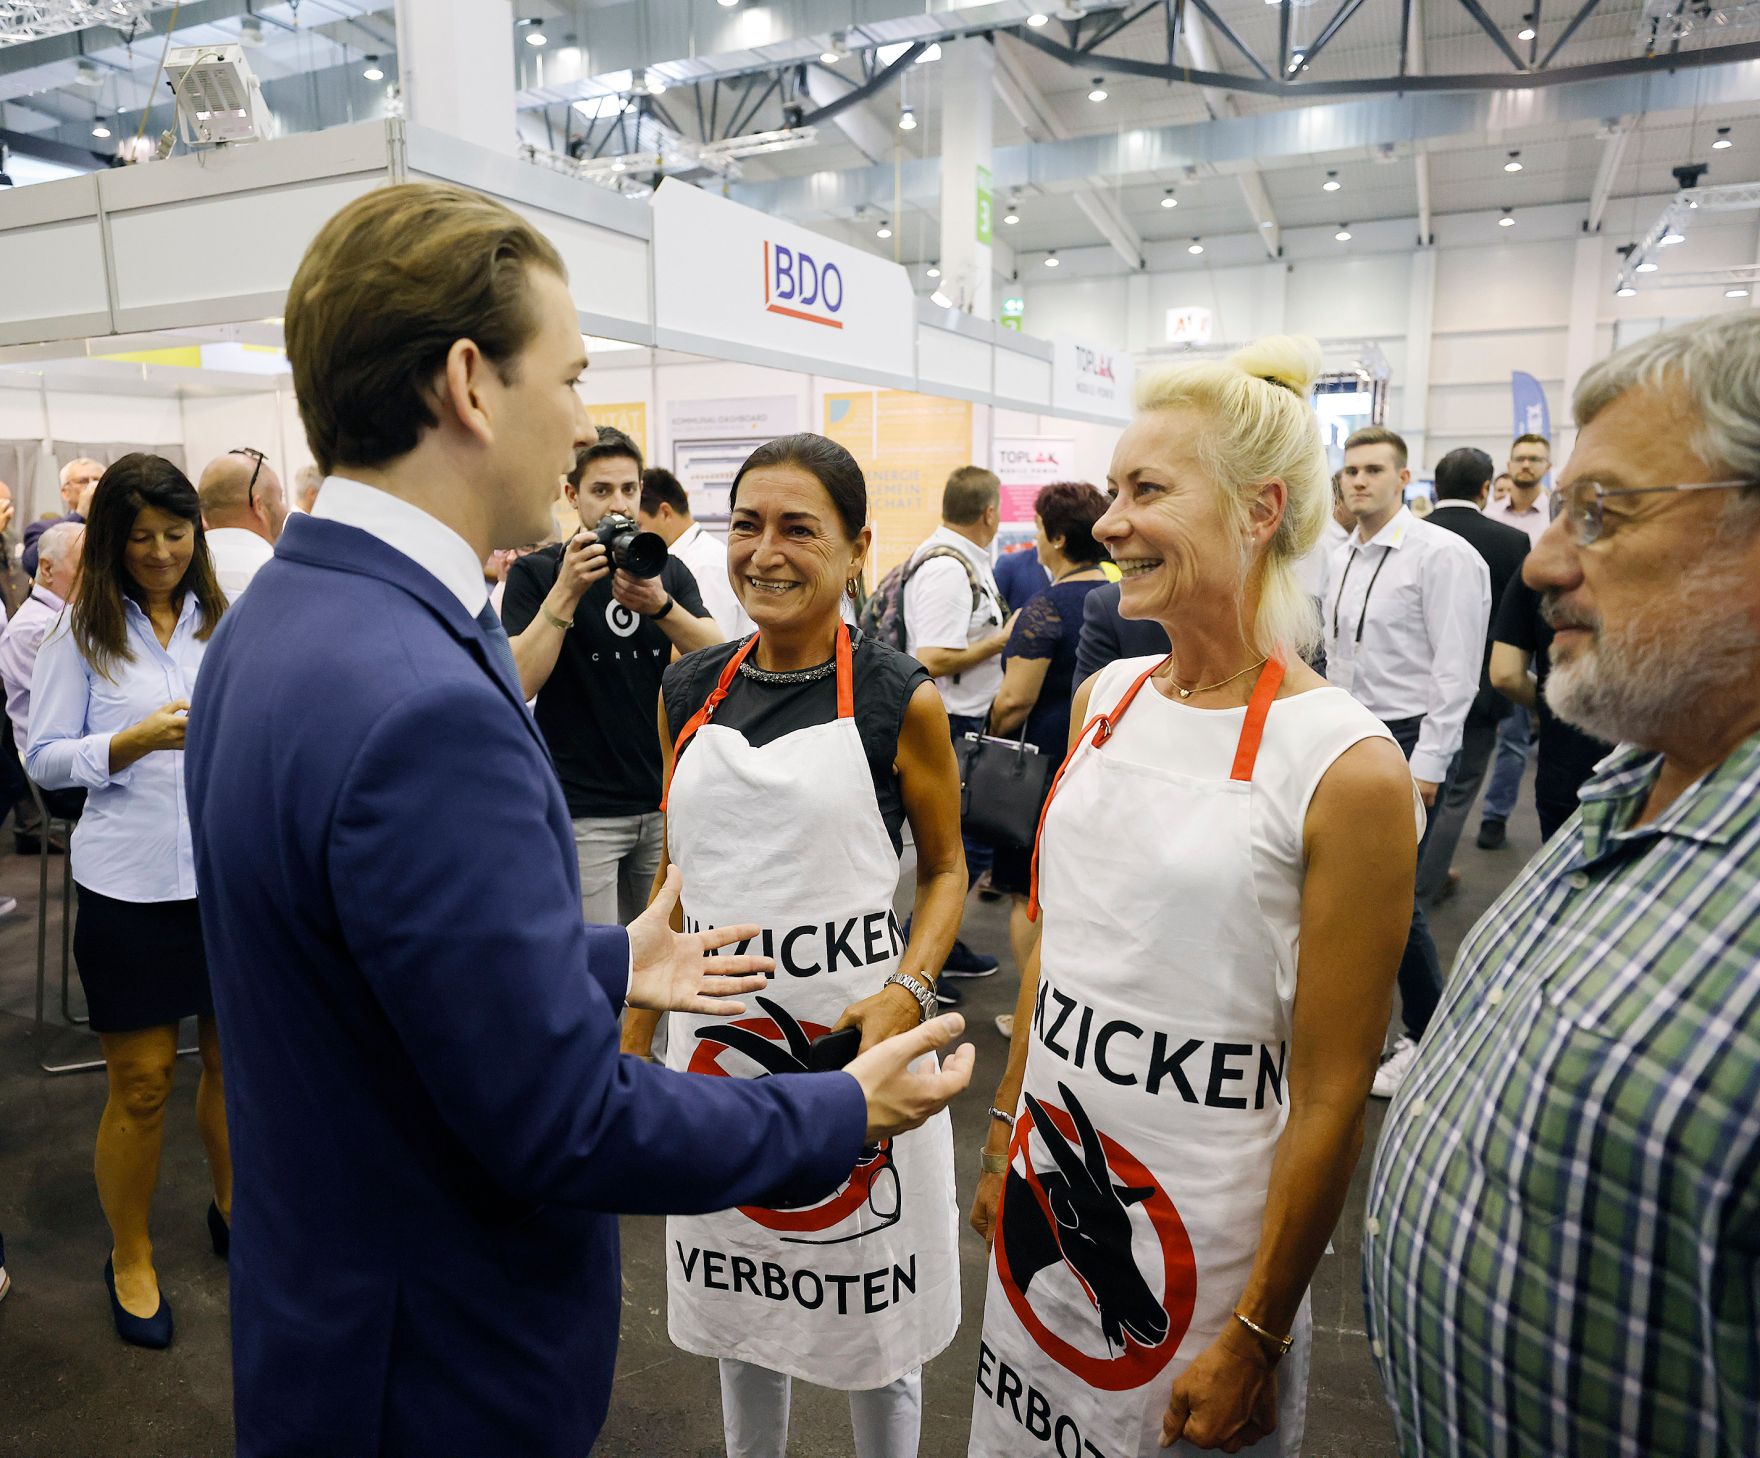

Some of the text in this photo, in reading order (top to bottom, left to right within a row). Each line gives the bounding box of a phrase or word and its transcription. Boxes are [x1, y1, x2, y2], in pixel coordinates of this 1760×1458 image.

[775, 244, 843, 313] BDO
[592, 649, 660, 661] CREW
[676, 1240, 916, 1315] VERBOTEN
